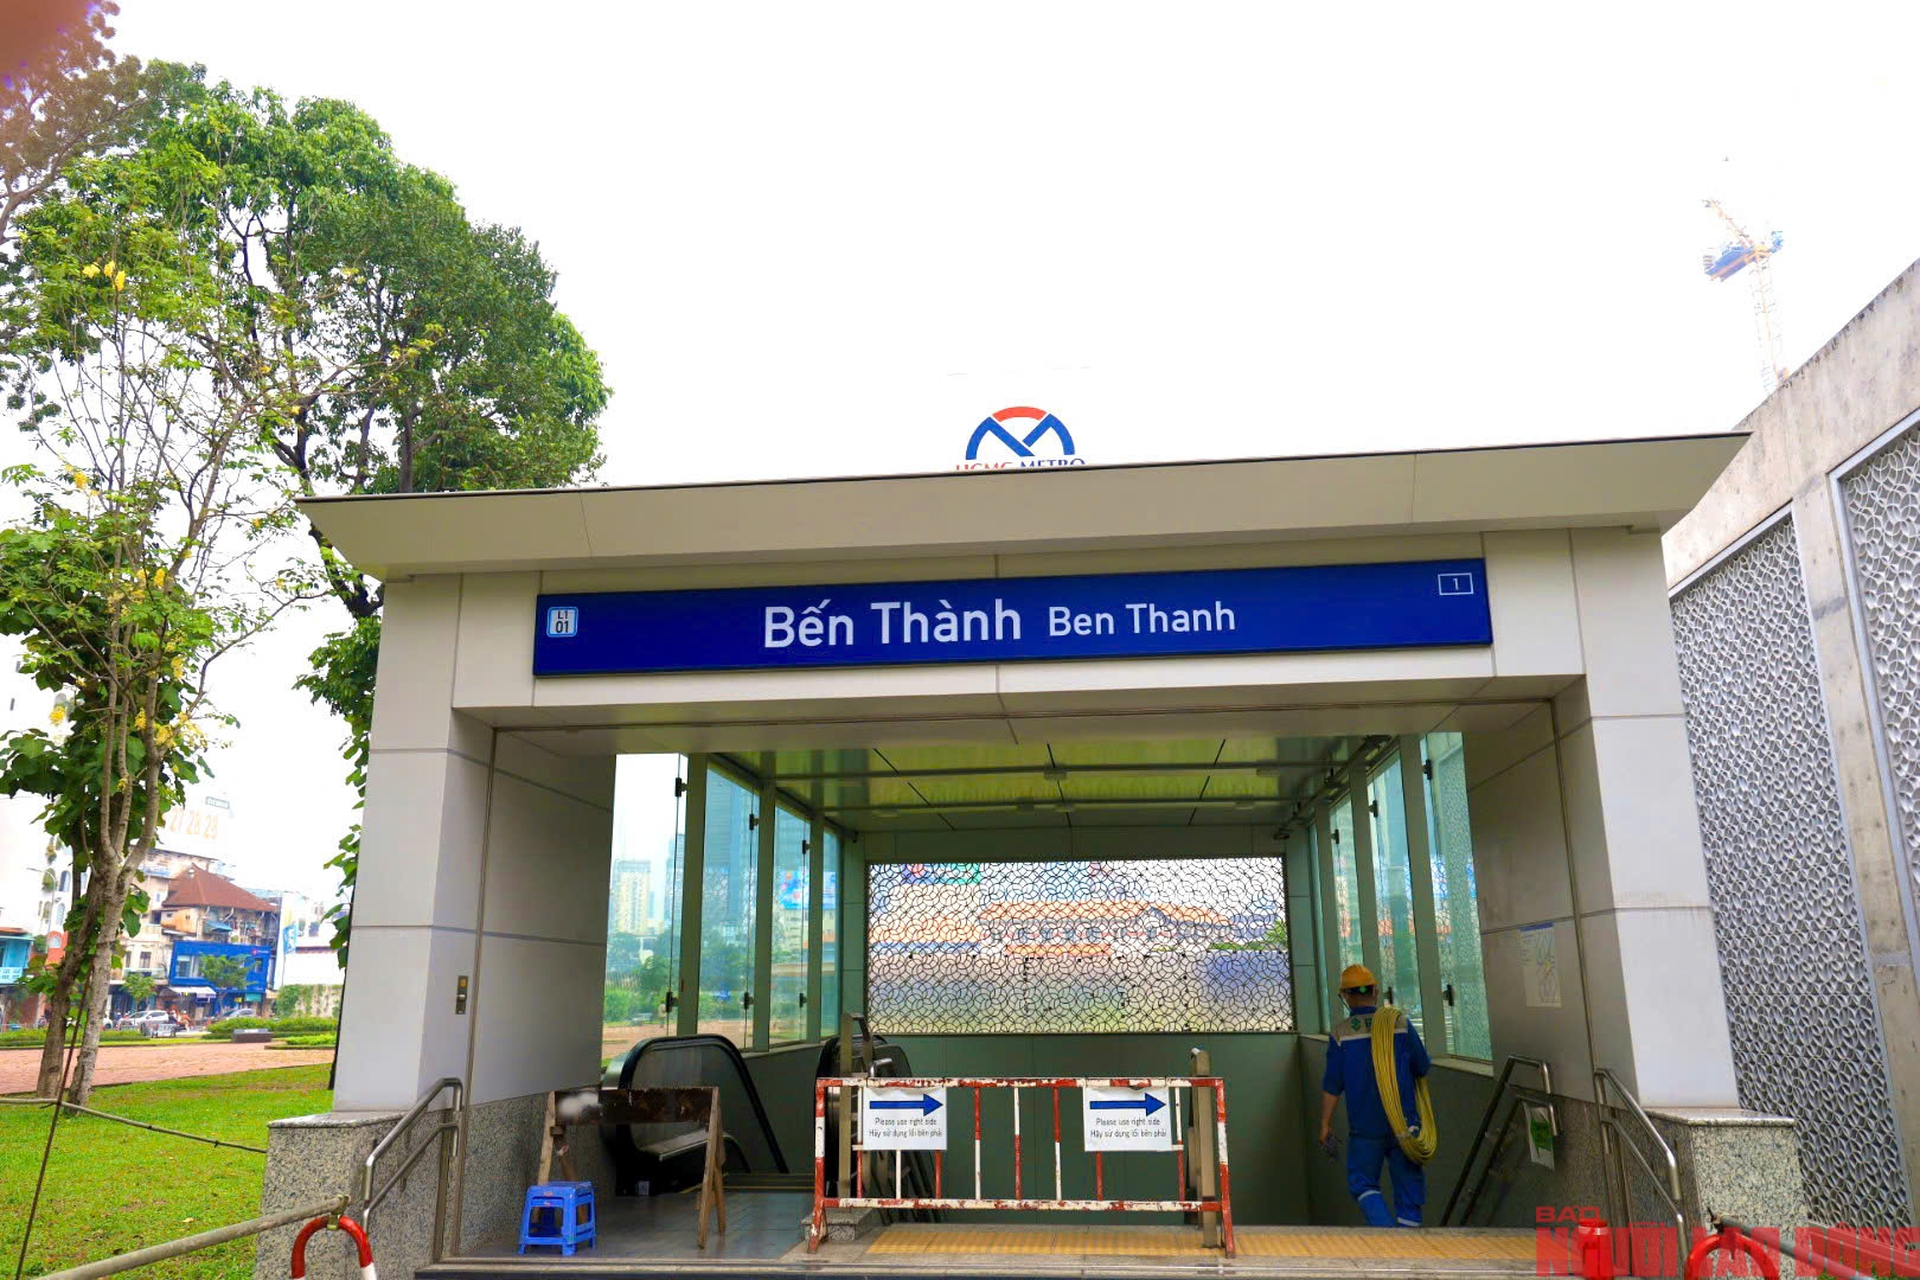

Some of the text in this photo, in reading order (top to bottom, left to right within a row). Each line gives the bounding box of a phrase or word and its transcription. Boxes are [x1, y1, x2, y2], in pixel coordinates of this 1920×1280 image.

[1453, 577, 1459, 590] 1
[555, 620, 569, 633] 01
[765, 599, 1235, 647] Bến Thành Ben Thanh
[874, 1117, 895, 1126] Please
[909, 1117, 923, 1127] right
[925, 1117, 937, 1126] side
[1095, 1117, 1116, 1126] Please
[1131, 1117, 1146, 1127] right
[1147, 1117, 1161, 1126] side
